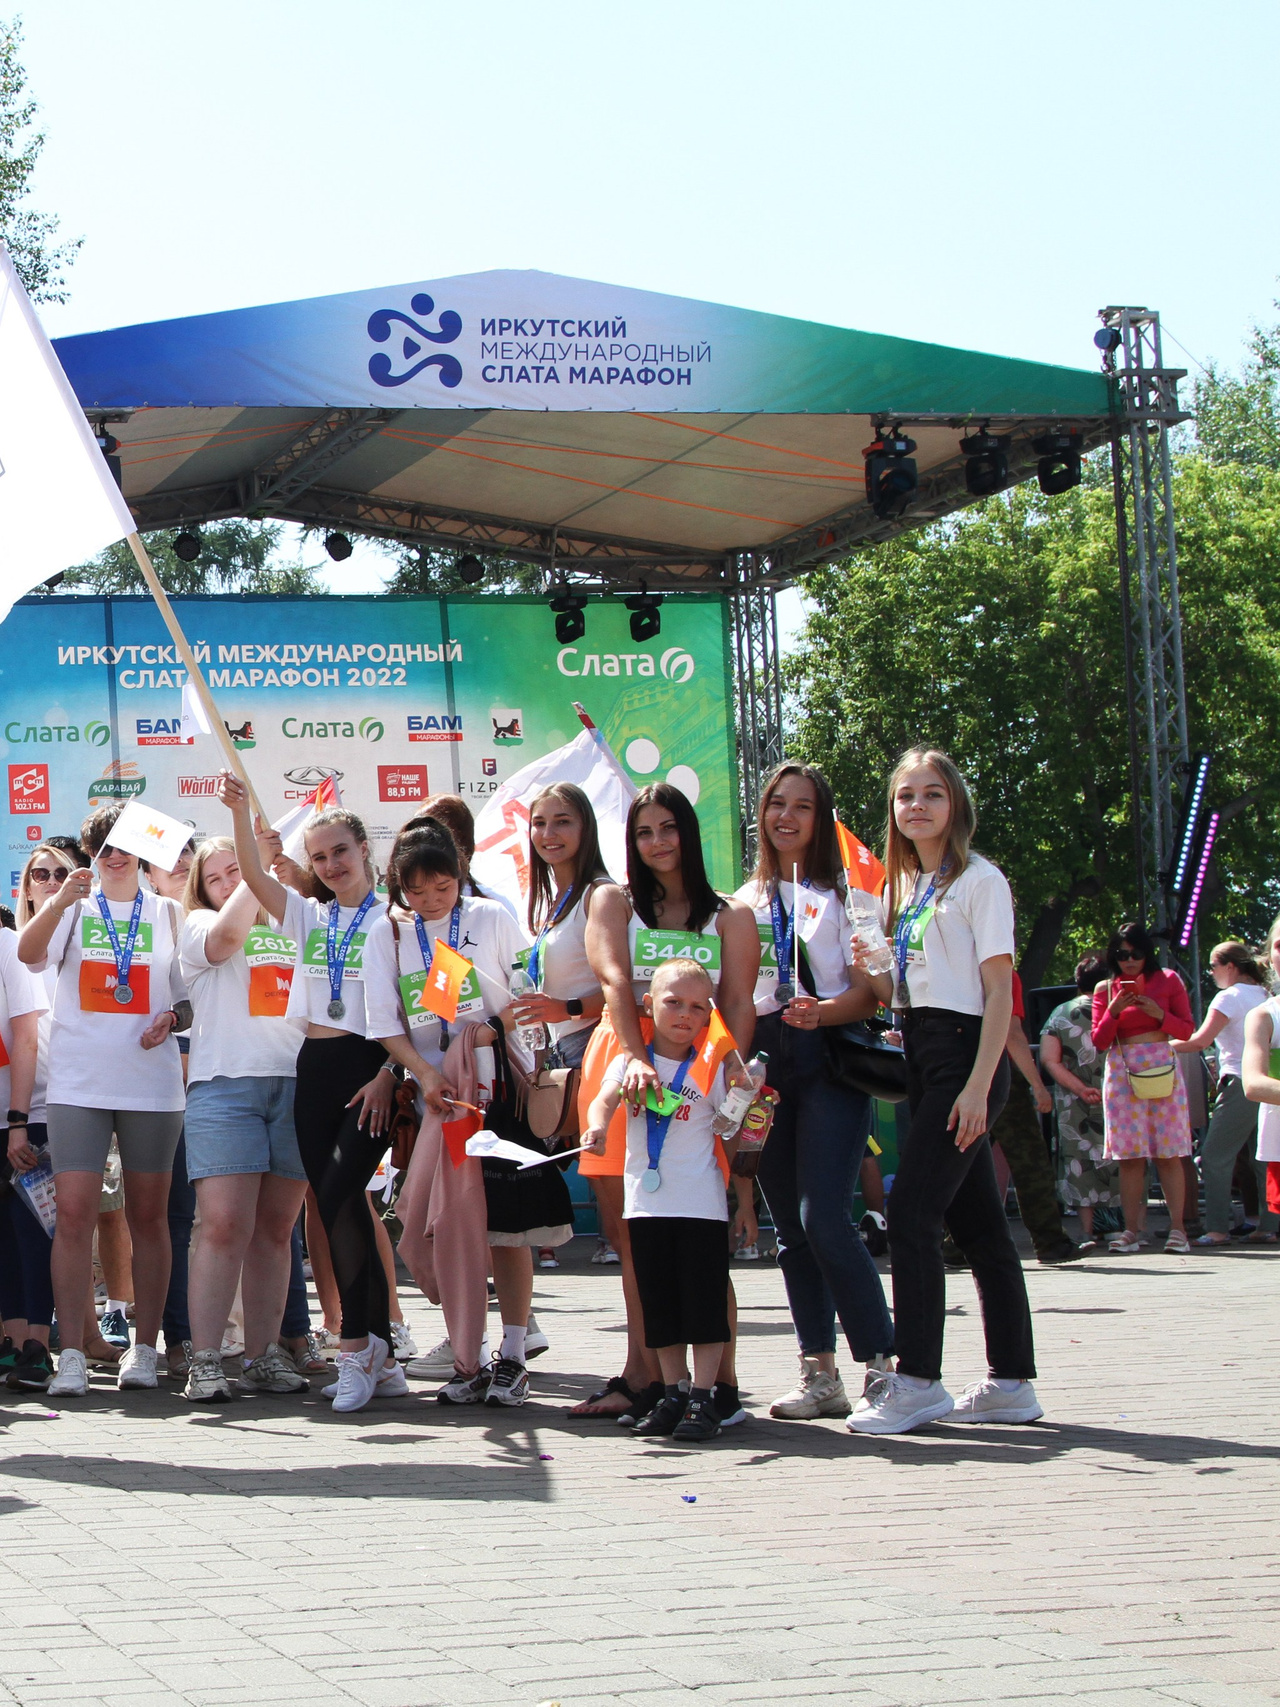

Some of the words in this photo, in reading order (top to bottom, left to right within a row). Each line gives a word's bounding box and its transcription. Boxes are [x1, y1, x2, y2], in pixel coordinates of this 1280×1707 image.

[481, 316, 627, 338] ИРКУТСКИЙ
[481, 341, 712, 364] МЕЖДУНАРОДНЫЙ
[481, 365, 560, 384] СЛАТА
[569, 366, 692, 386] МАРАФОН
[219, 639, 463, 667] МЕЖДУНАРОДНЫЙ
[557, 647, 655, 677] Слата
[209, 668, 340, 687] МАРАФОН
[347, 667, 407, 687] 2022
[5, 722, 80, 743] Слата
[282, 717, 354, 738] Слата
[407, 716, 462, 730] БАМ
[93, 782, 140, 793] КАРАВАЙ
[180, 779, 214, 795] World
[387, 788, 406, 797] 88,9
[408, 787, 421, 796] FM
[251, 937, 297, 953] 2612
[312, 943, 364, 962] 227
[642, 942, 712, 963] 3440
[409, 977, 473, 1008] 28
[417, 1013, 437, 1023] Слат
[675, 1105, 690, 1121] 28
